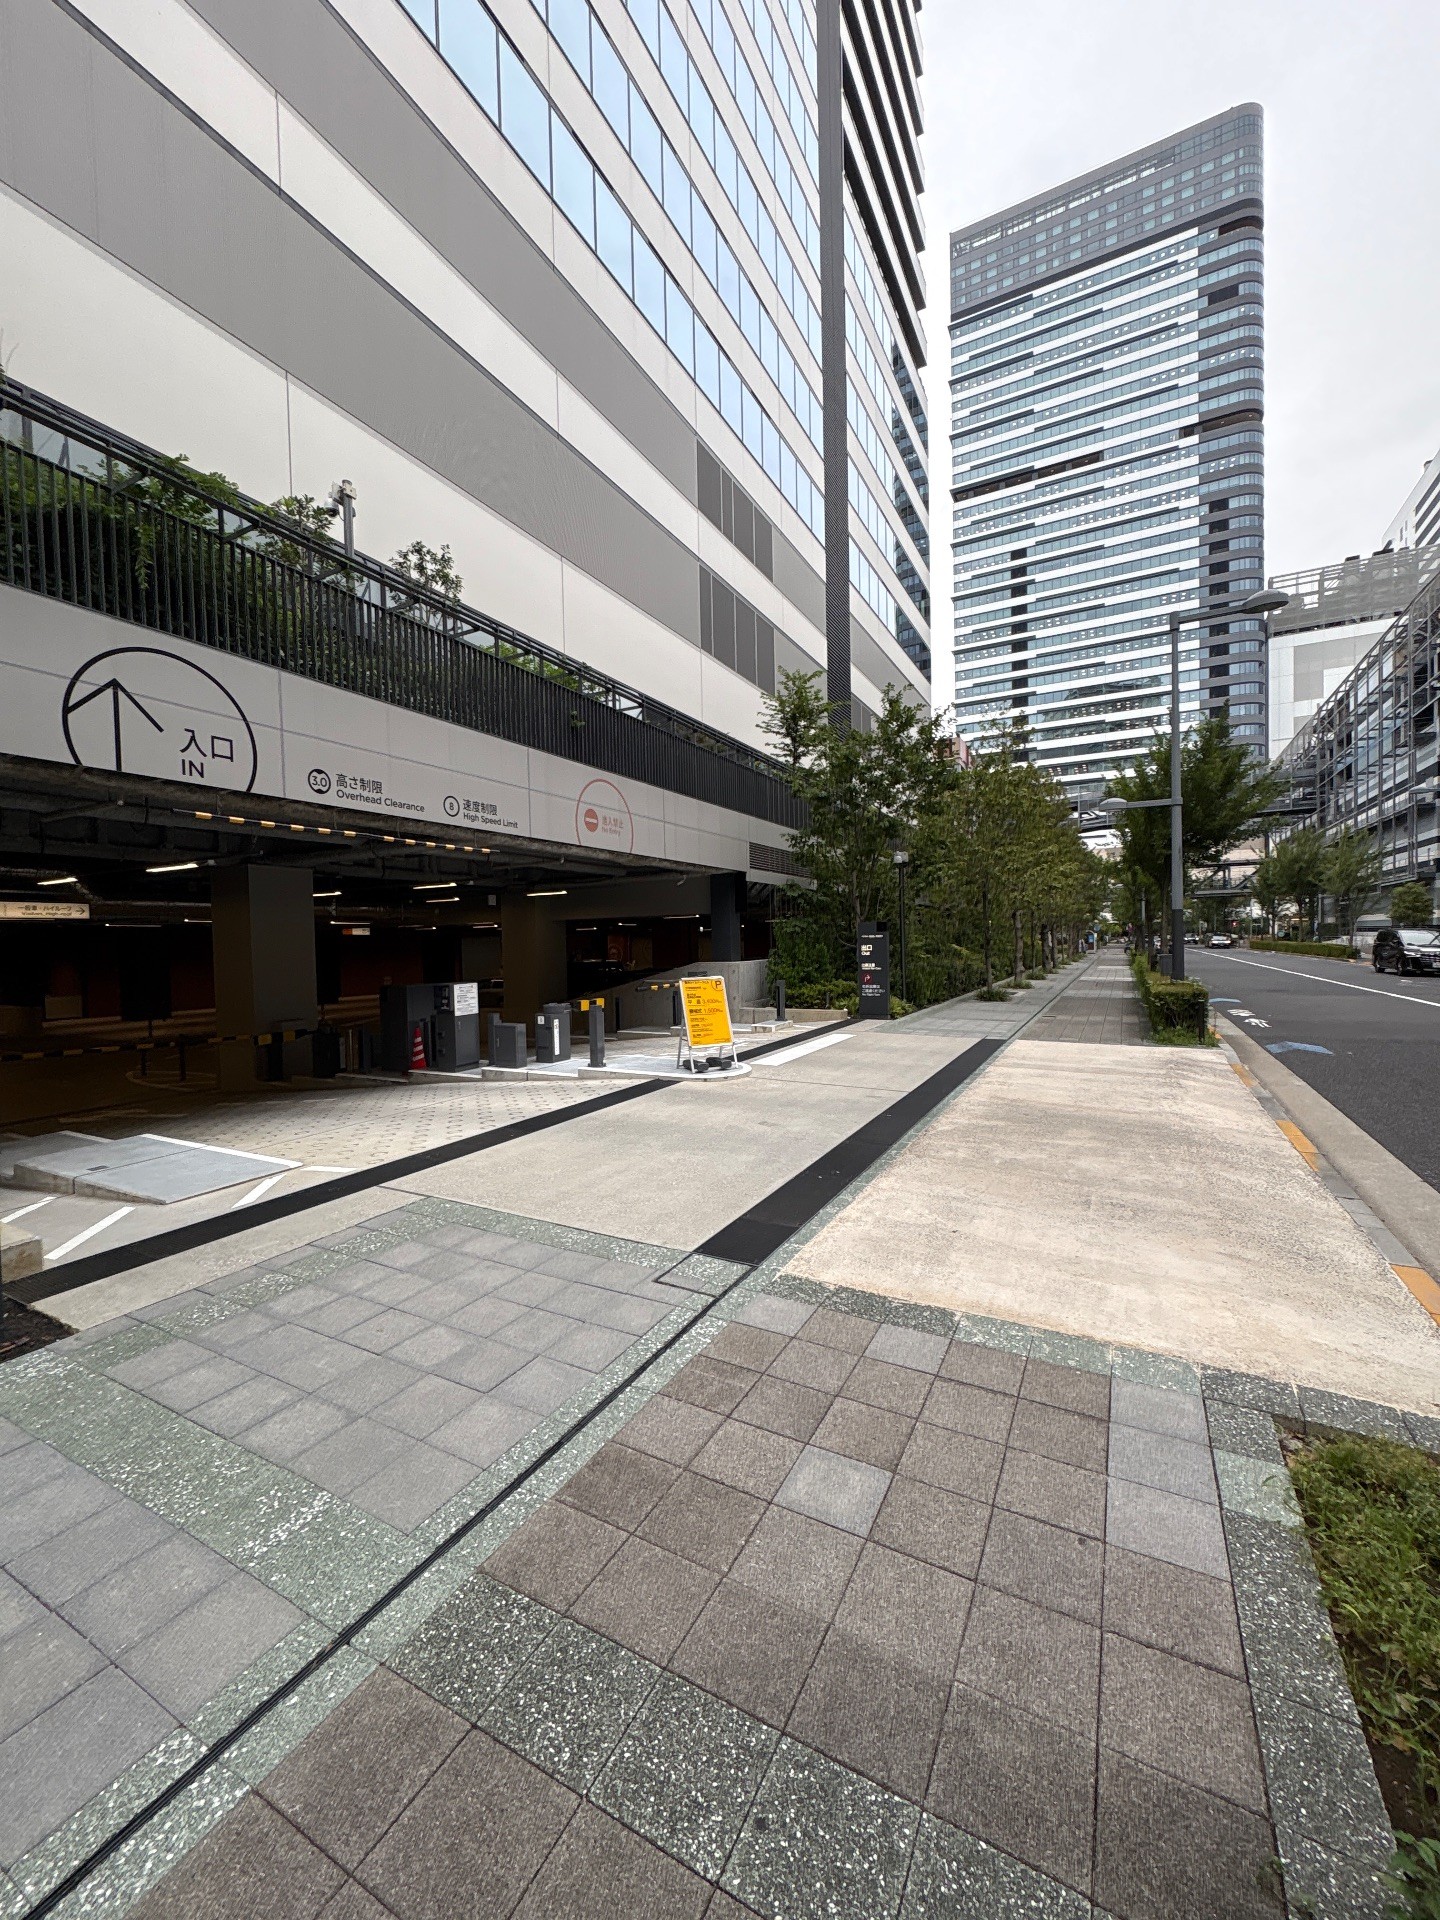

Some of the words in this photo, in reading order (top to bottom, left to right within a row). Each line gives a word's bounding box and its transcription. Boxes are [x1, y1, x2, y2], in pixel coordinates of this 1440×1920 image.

[180, 728, 234, 762] 入口
[182, 759, 204, 778] IN
[311, 775, 328, 788] 3.0
[335, 773, 383, 795] 高さ制限
[336, 789, 382, 805] Overhead
[384, 797, 425, 812] Clearance
[462, 798, 498, 816] 速度制限
[463, 812, 480, 823] High
[480, 815, 502, 826] Speed
[502, 818, 518, 829] Limit
[714, 980, 722, 990] P
